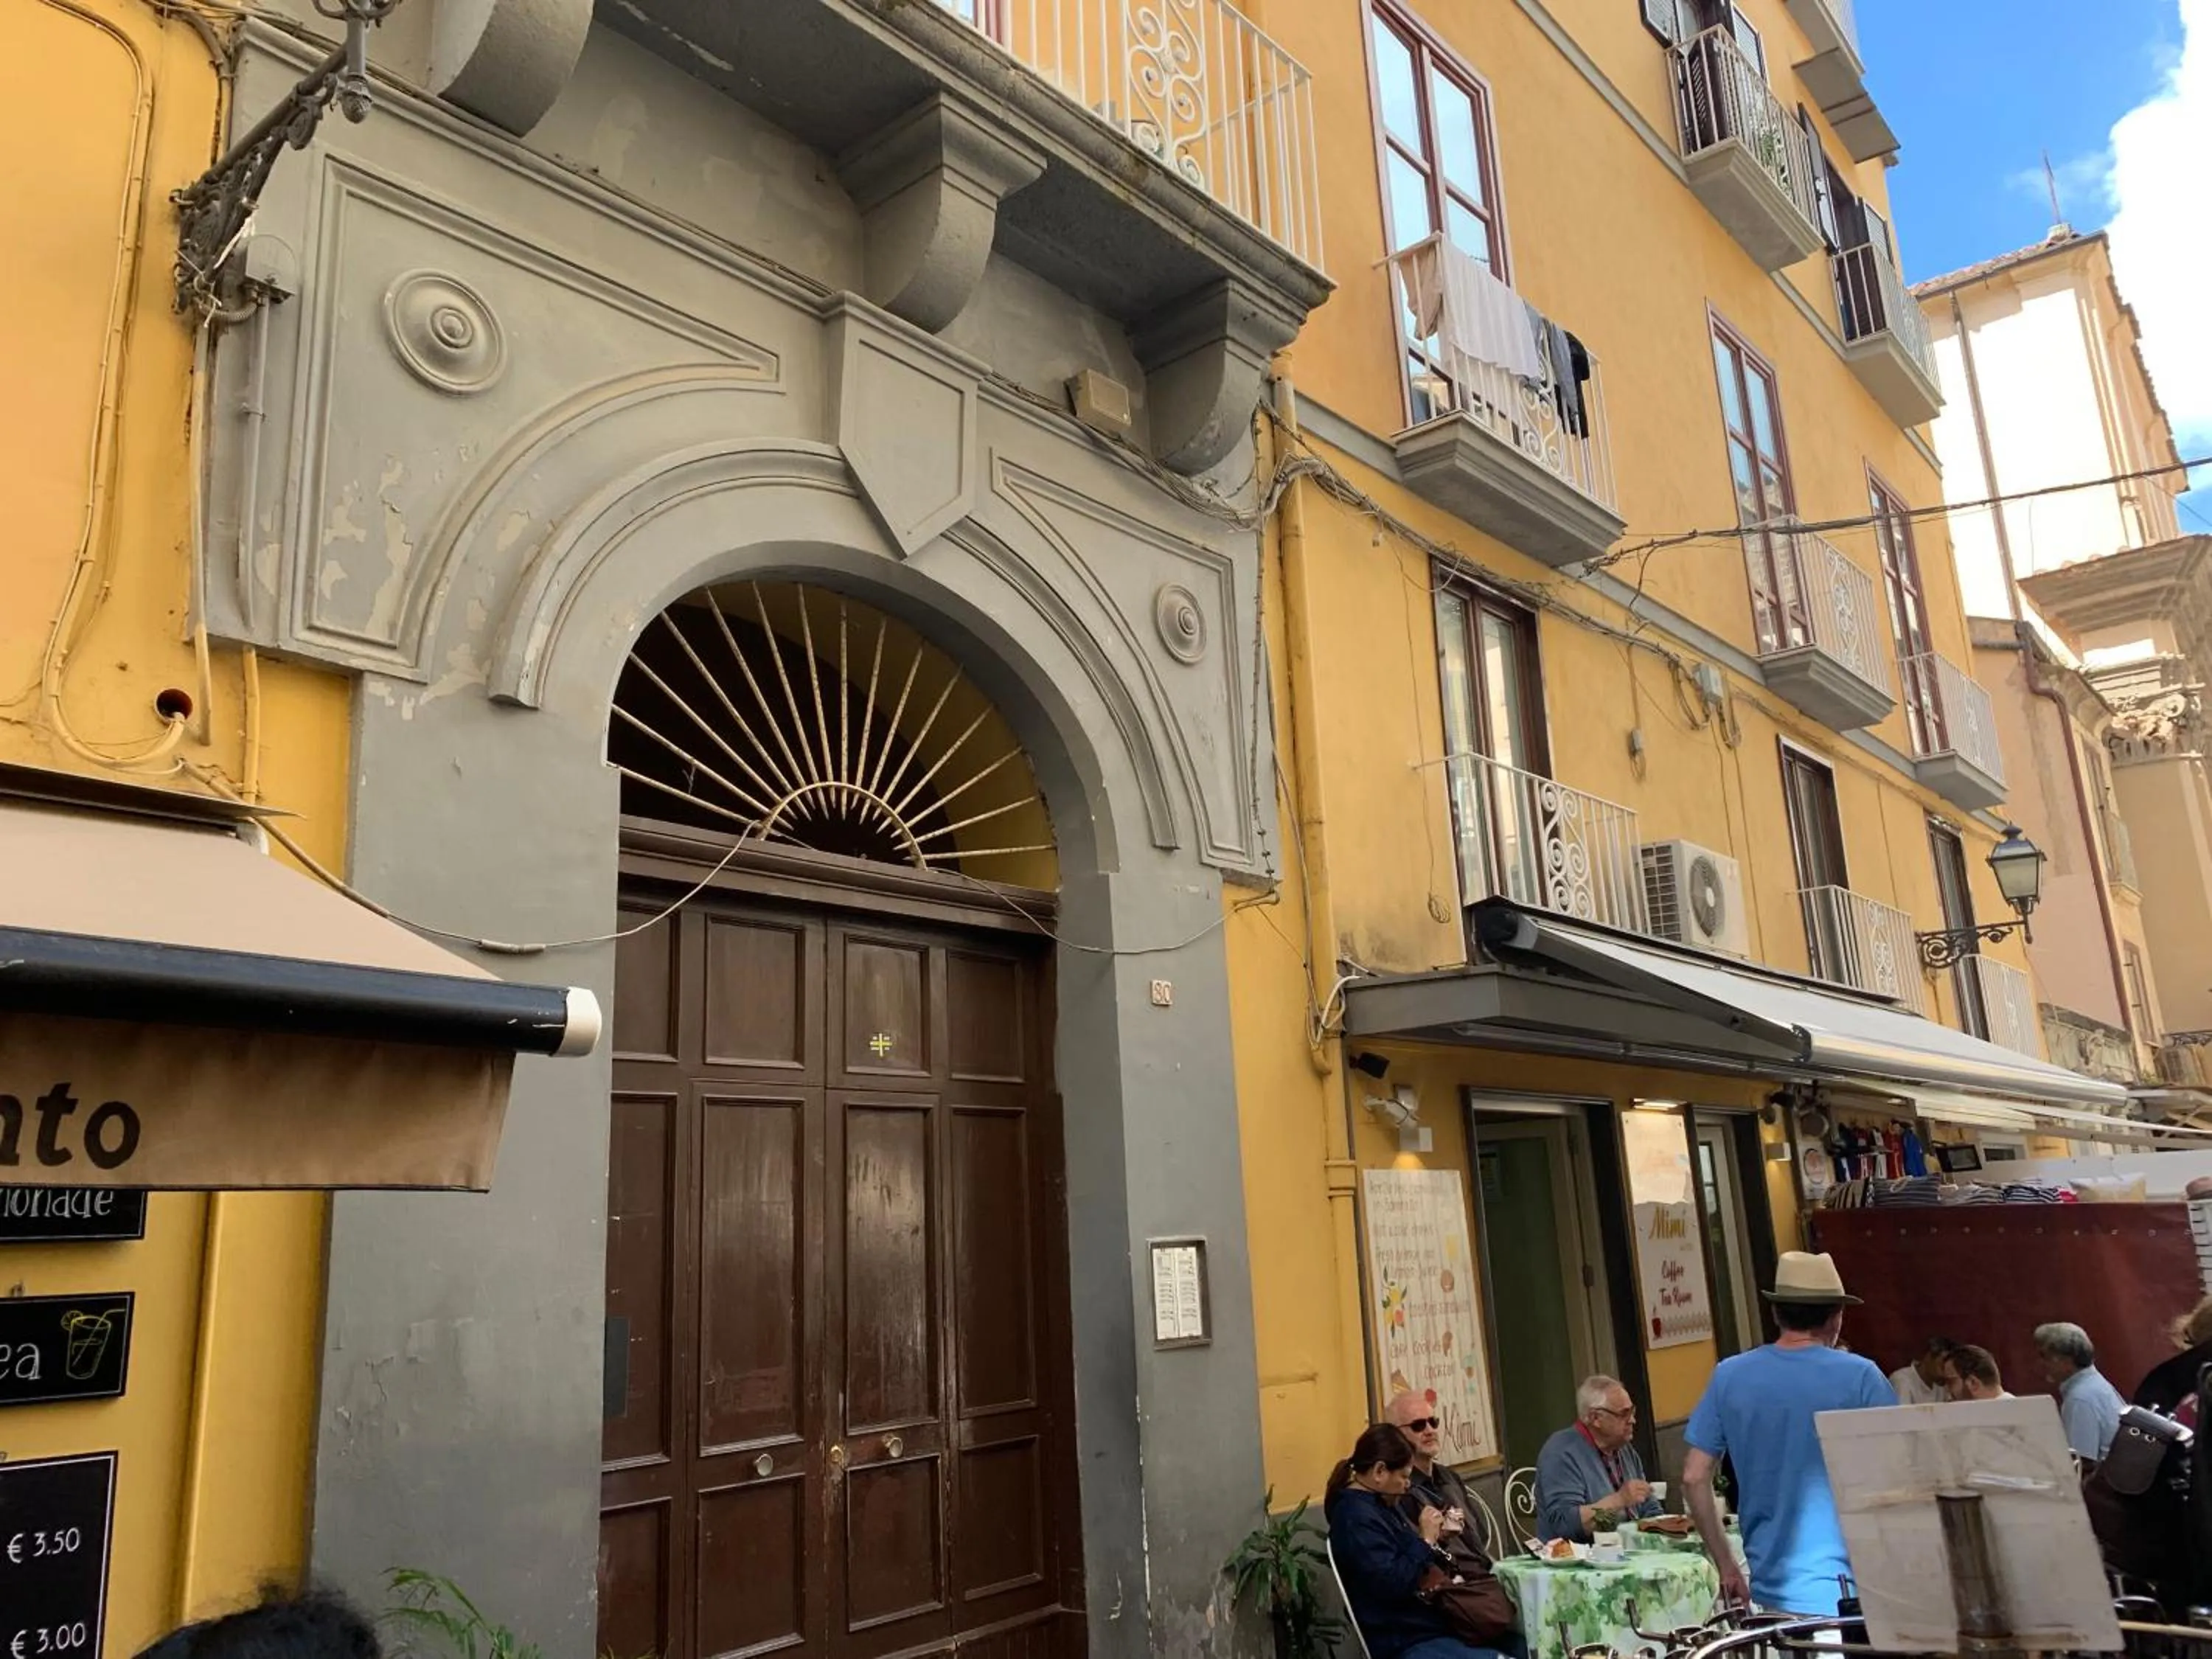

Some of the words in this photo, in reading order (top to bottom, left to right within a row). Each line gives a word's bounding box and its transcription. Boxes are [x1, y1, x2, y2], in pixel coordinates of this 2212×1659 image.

[0, 1189, 114, 1218] onade
[7, 1532, 25, 1564] €
[32, 1526, 80, 1557] 3.50
[10, 1629, 28, 1659] €
[36, 1622, 86, 1654] 3.00
